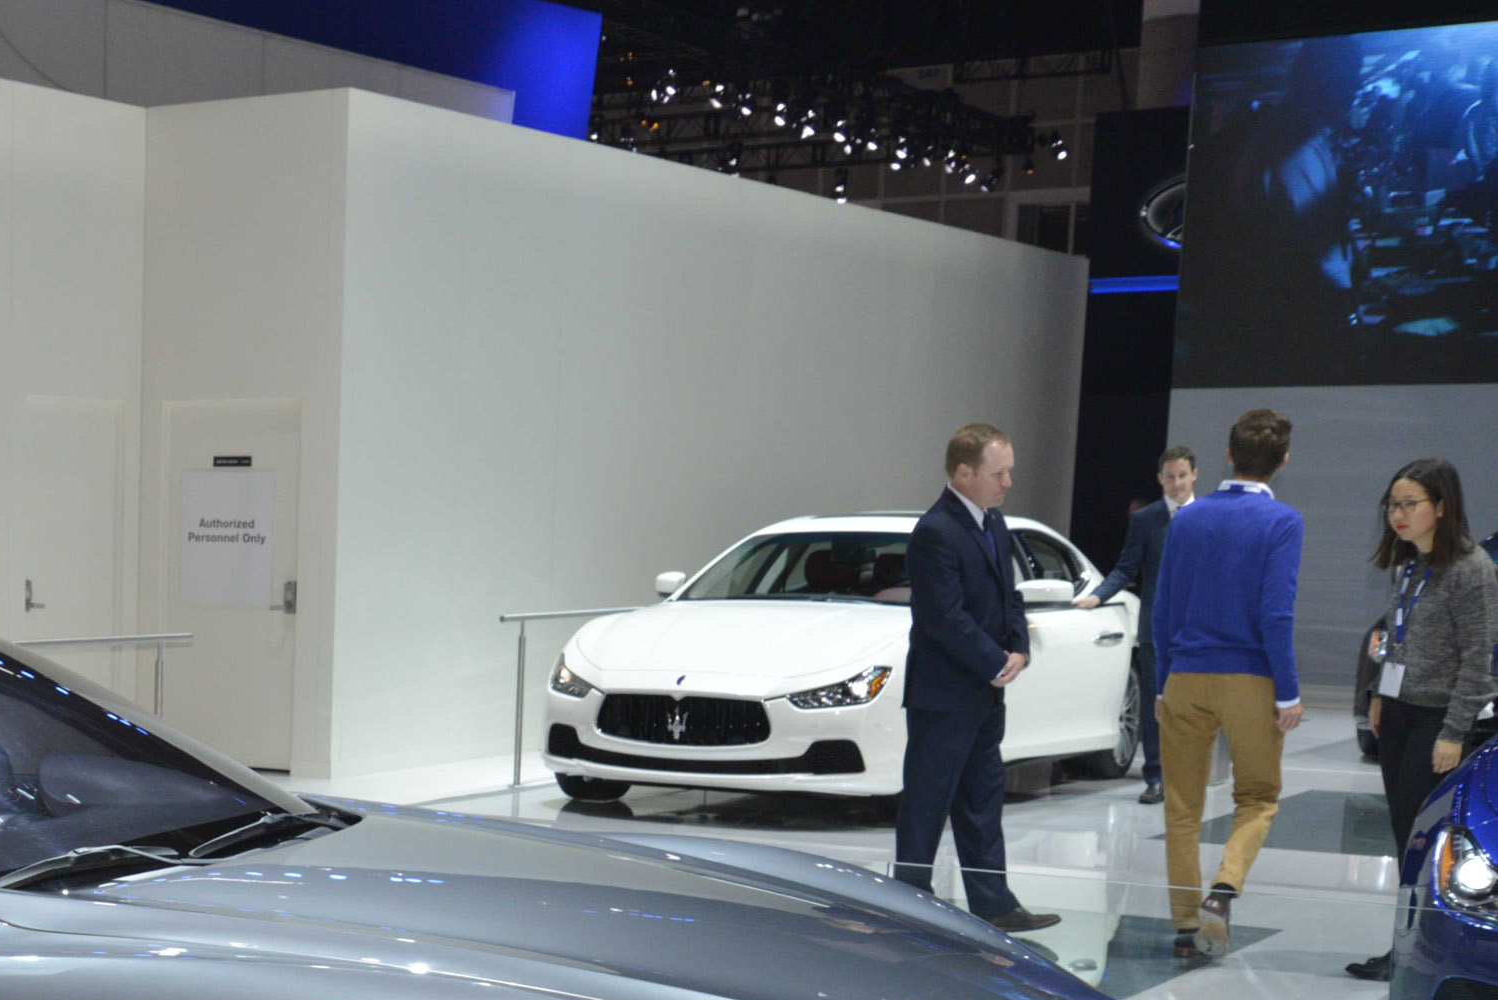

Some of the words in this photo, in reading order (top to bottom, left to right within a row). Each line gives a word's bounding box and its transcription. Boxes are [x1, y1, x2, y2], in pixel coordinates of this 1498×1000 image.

[199, 518, 254, 528] Authorized
[188, 532, 239, 543] Personnel
[242, 533, 265, 545] Only
